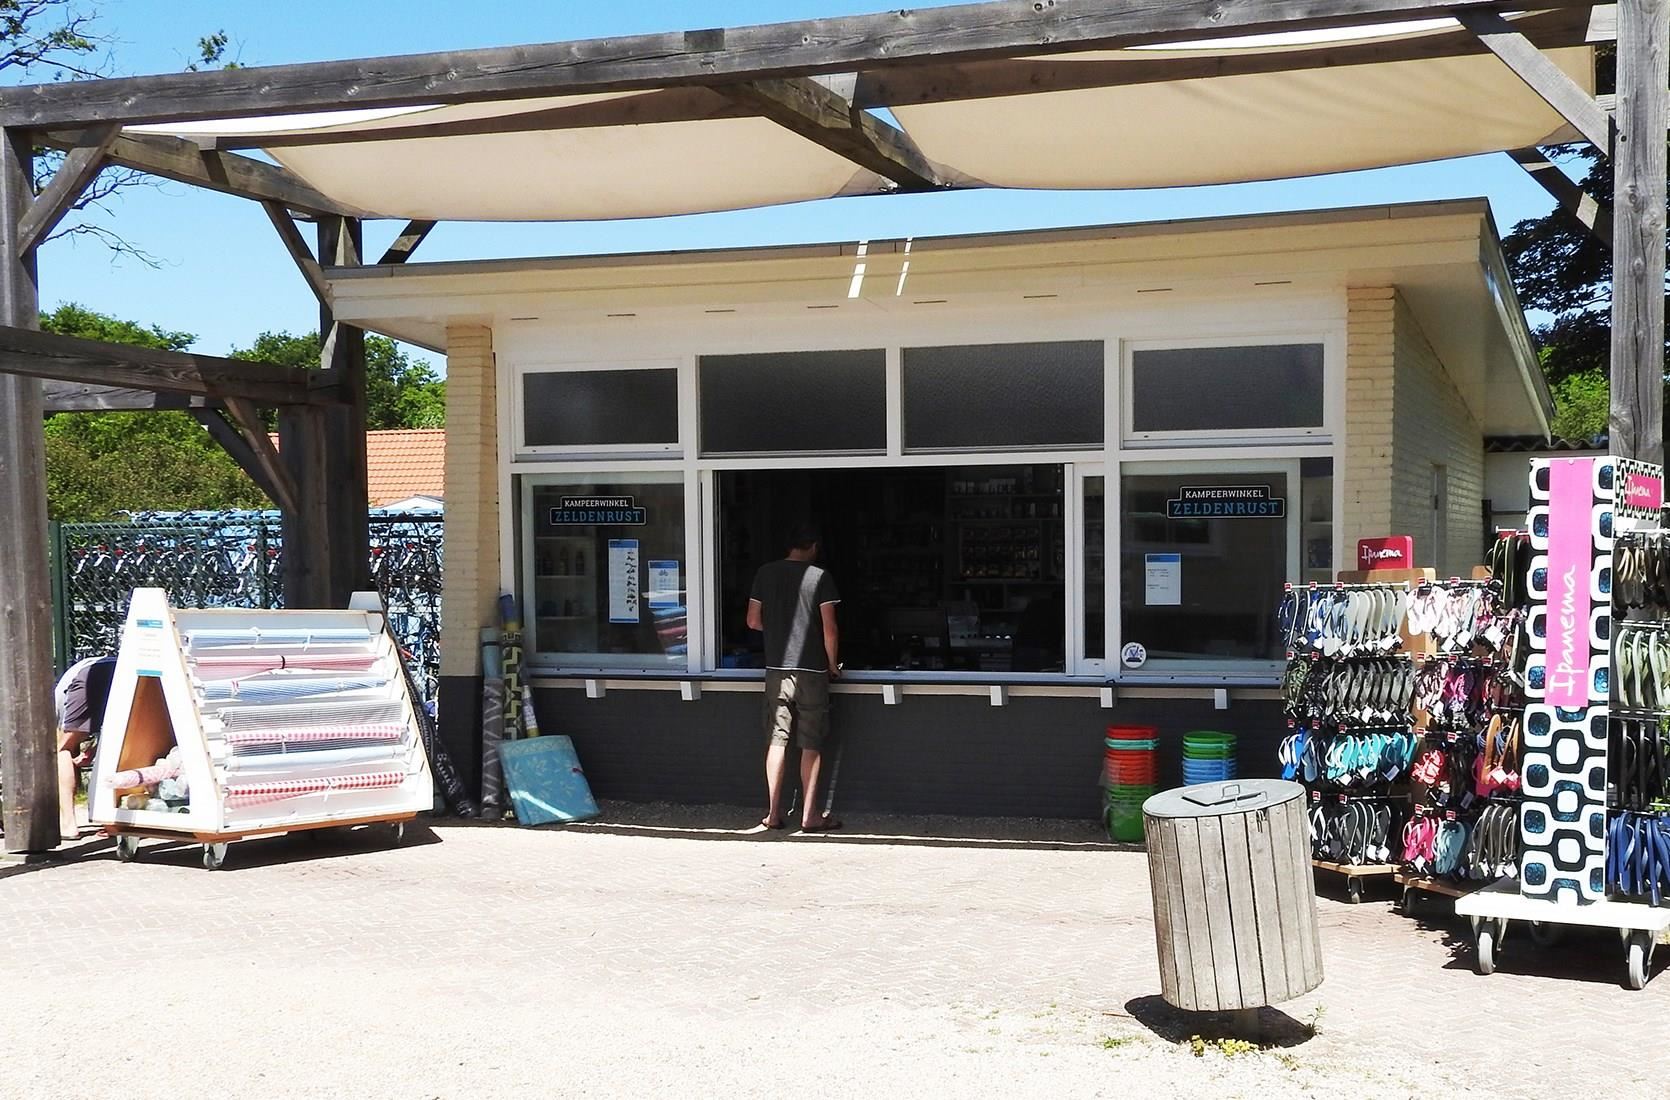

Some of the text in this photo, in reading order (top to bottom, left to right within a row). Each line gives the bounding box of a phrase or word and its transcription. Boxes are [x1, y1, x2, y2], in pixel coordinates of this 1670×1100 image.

[1185, 490, 1264, 498] KAMPEERWINKEL
[1173, 502, 1279, 515] ZELDENRUST
[555, 511, 641, 522] ZELDENRUST
[1549, 564, 1585, 697] Ipanema
